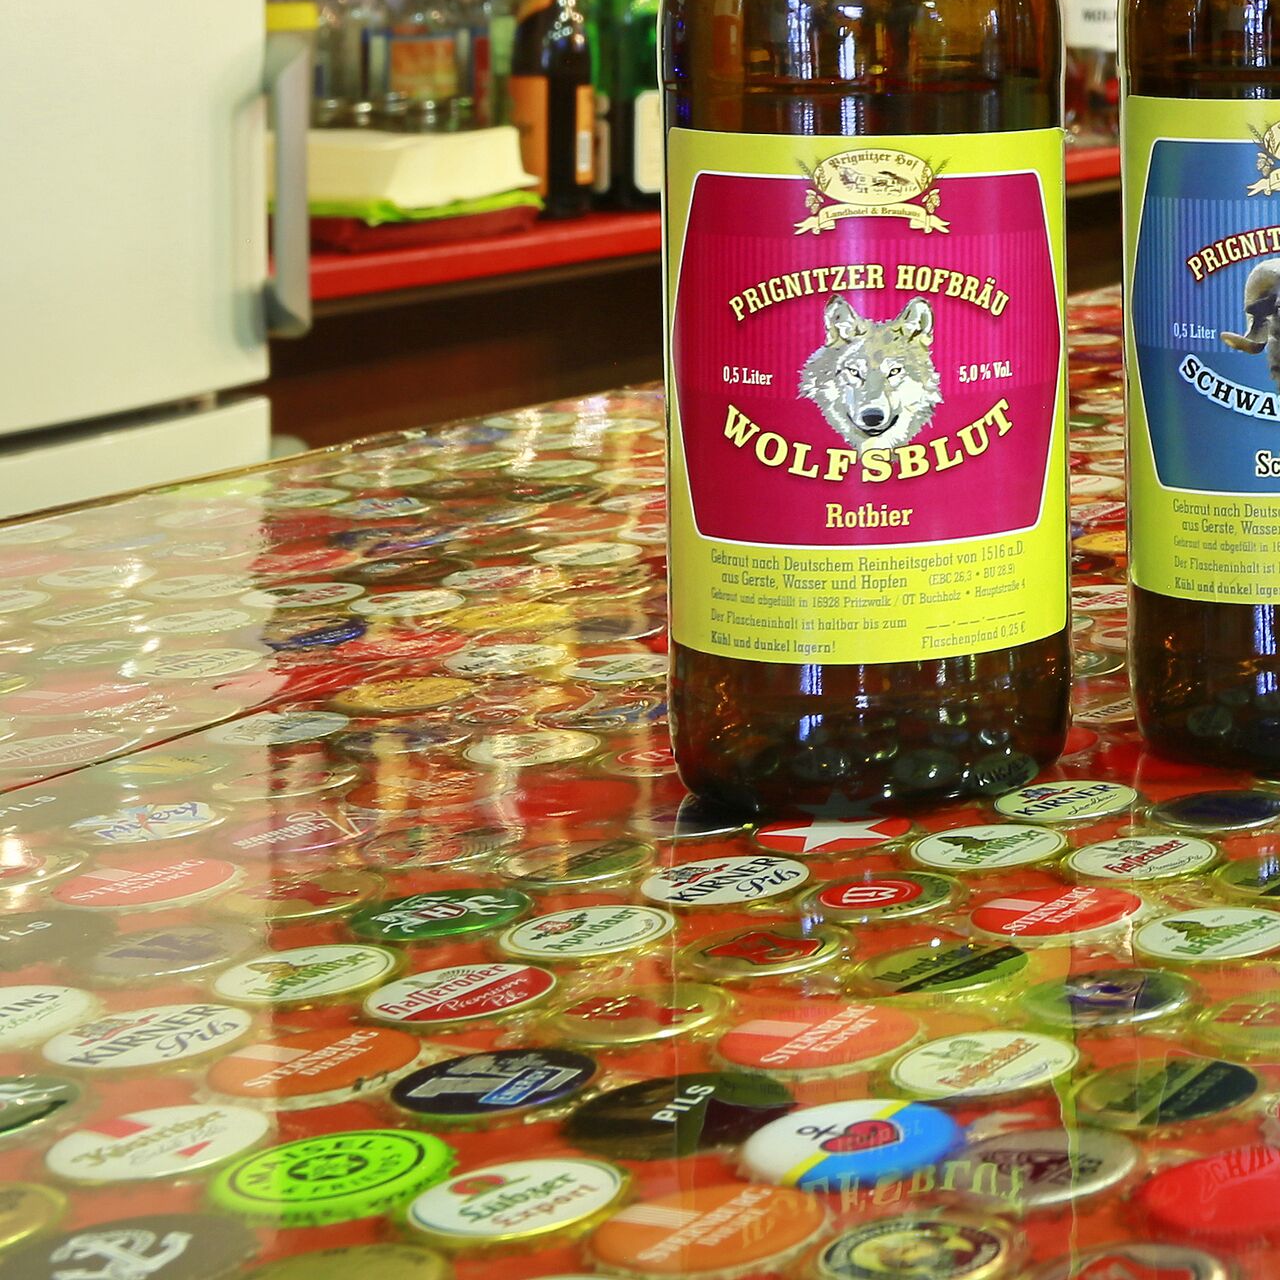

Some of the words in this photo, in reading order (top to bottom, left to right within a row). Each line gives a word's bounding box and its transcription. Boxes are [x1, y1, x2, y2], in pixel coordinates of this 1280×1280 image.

[824, 208, 868, 219] Landhotel
[870, 207, 878, 215] &
[880, 207, 921, 218] Brauhaus
[728, 264, 885, 322] PRIGNITZER
[895, 265, 1010, 317] HOFBRÄU
[1173, 322, 1188, 338] 0,5
[1190, 324, 1217, 339] Liter
[722, 366, 739, 383] 0,5
[742, 368, 773, 385] Liter
[959, 367, 978, 383] 5,0
[981, 365, 991, 379] %
[994, 361, 1012, 378] Vol.
[722, 398, 1014, 483] WOLFSBLUT
[825, 503, 913, 529] Rotbier
[1173, 499, 1211, 516] Gebraut
[1213, 500, 1240, 518] nach
[1182, 521, 1198, 532] aus
[1201, 519, 1237, 535] Gerste,
[711, 549, 749, 568] Gebraut
[751, 551, 779, 571] nach
[784, 556, 854, 572] Deutschem
[858, 551, 953, 573] Reinheitsgebot
[956, 551, 977, 564] von
[981, 543, 1006, 561] 1516
[722, 572, 739, 584] aus
[741, 572, 779, 590] Gerste,
[782, 574, 828, 590] Wasser
[832, 575, 856, 590] und
[860, 574, 907, 594] Hopfen
[1014, 782, 1121, 818] KIRNER
[666, 857, 787, 903] KIRNER
[736, 869, 801, 898] Pils
[67, 1005, 228, 1066] KIRNER
[155, 1019, 239, 1058] Pils
[652, 1084, 716, 1122] PILS
